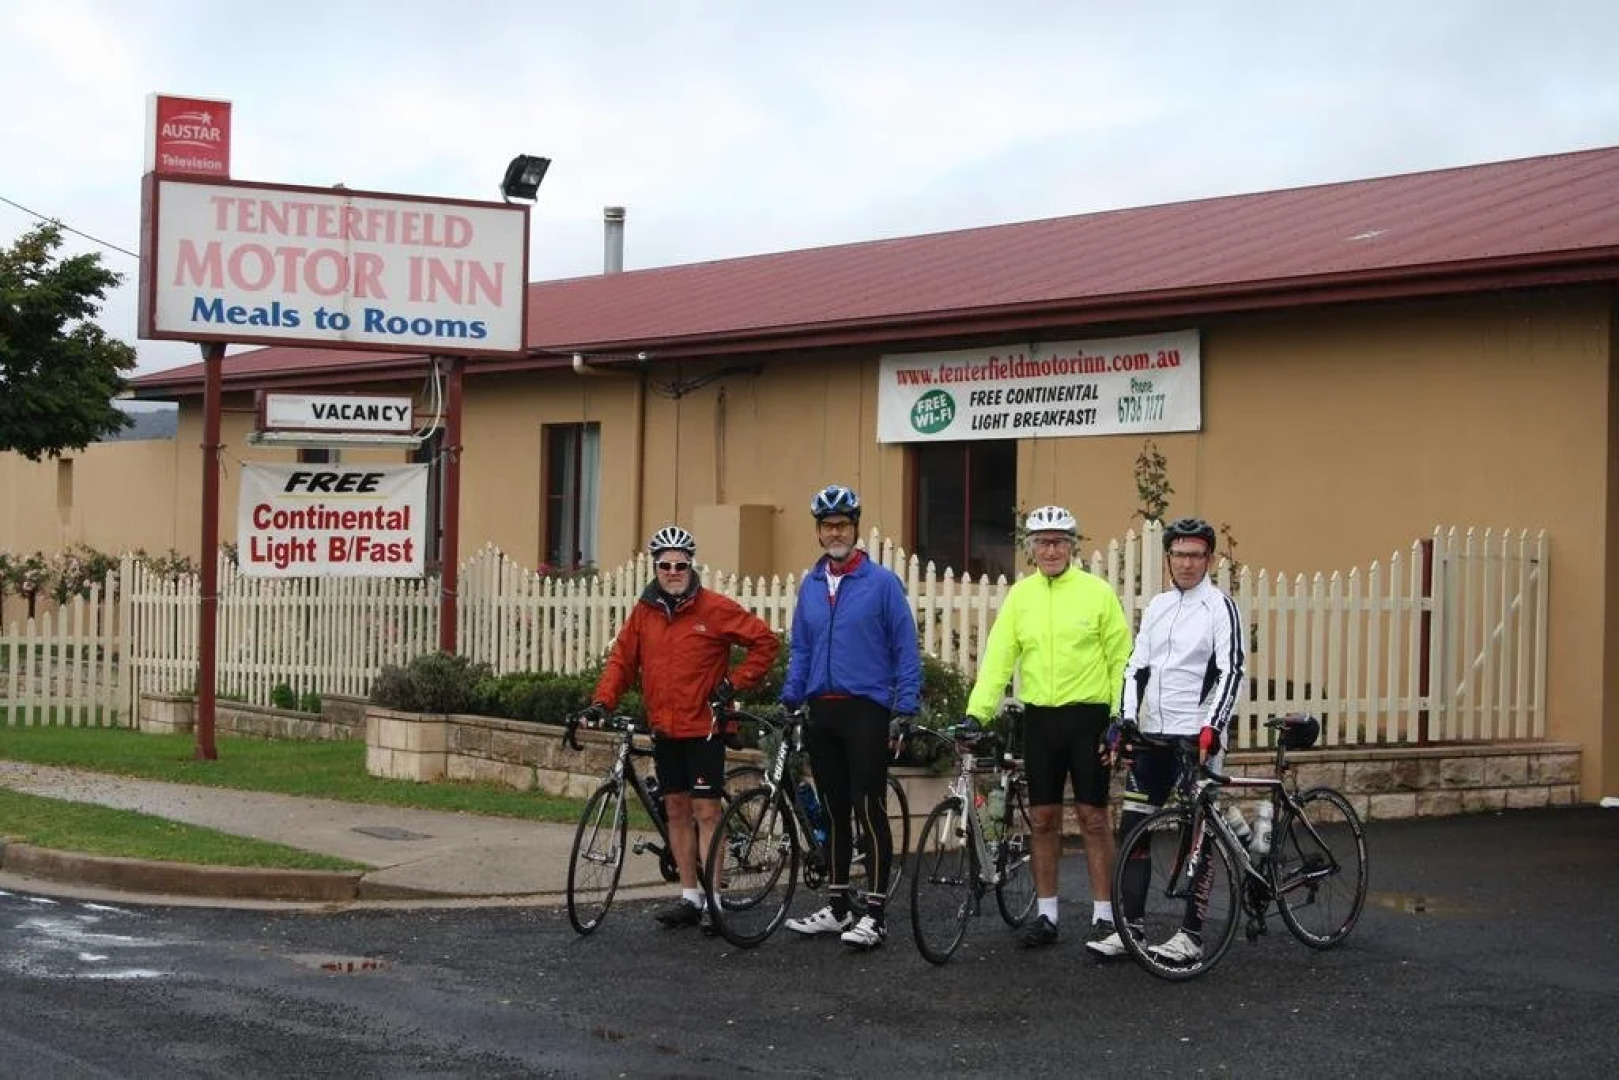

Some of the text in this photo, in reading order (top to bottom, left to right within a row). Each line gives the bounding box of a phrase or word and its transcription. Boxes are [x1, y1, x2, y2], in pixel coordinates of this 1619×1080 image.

[162, 122, 221, 142] AUSTAR
[161, 153, 222, 170] Television
[210, 195, 474, 249] TENTERFIELD
[174, 238, 505, 307] MOTOR INN
[191, 296, 487, 339] Meals to Rooms
[896, 348, 1181, 387] www.tenterfieldmotorinn.com.au
[916, 393, 948, 414] FREE
[969, 383, 1099, 408] FREE CONTINENTAL
[311, 402, 409, 422] VACANCY
[914, 406, 952, 428] WI-FI
[971, 407, 1097, 431] LIGHT BREAKFAST!
[284, 472, 385, 493] FREE
[253, 503, 411, 531] Continental
[251, 535, 414, 569] Light B/Fast
